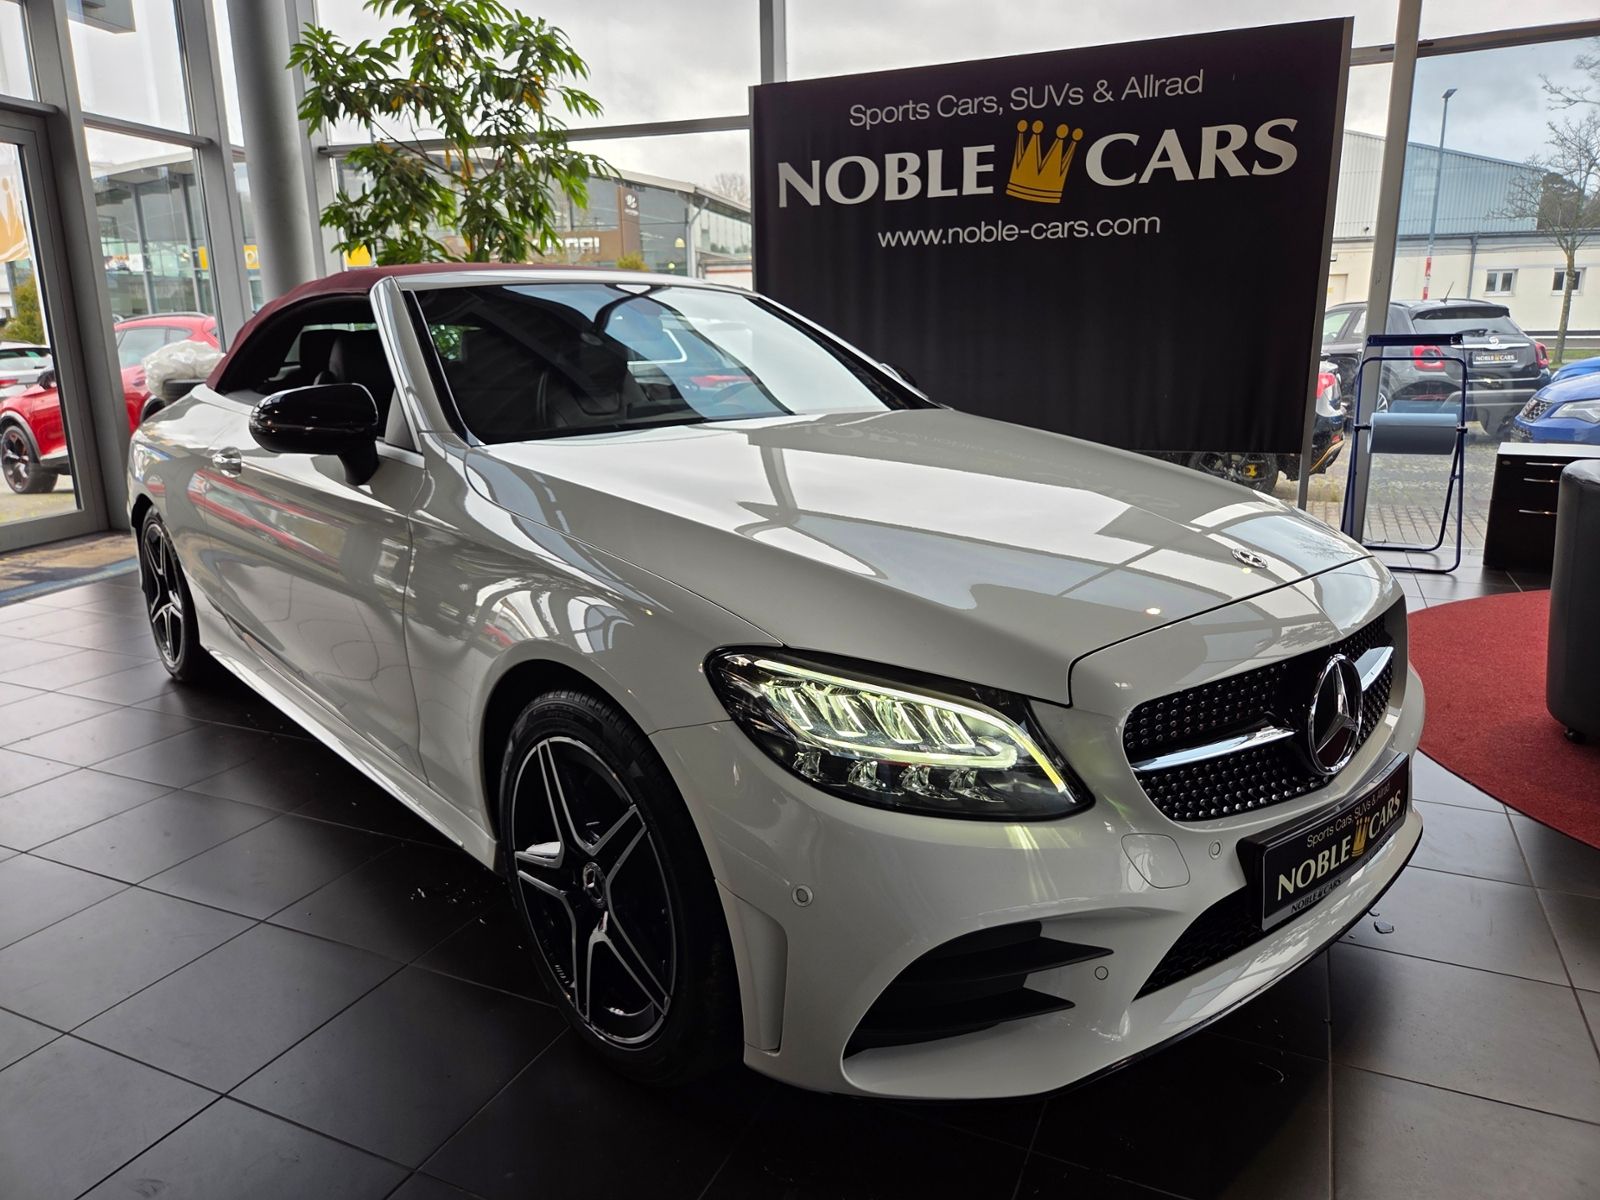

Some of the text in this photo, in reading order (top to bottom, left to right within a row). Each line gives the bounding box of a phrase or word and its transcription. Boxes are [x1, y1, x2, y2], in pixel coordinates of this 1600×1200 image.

[849, 69, 1204, 131] Sports Cars, SUVs & Allrad
[777, 118, 1299, 208] NOBLE CARS
[877, 216, 1162, 248] www.noble-cars.com
[1277, 835, 1351, 901] NOBLE
[1368, 789, 1401, 839] CARS
[1306, 824, 1334, 848] Sports
[1290, 892, 1317, 914] NOBLE
